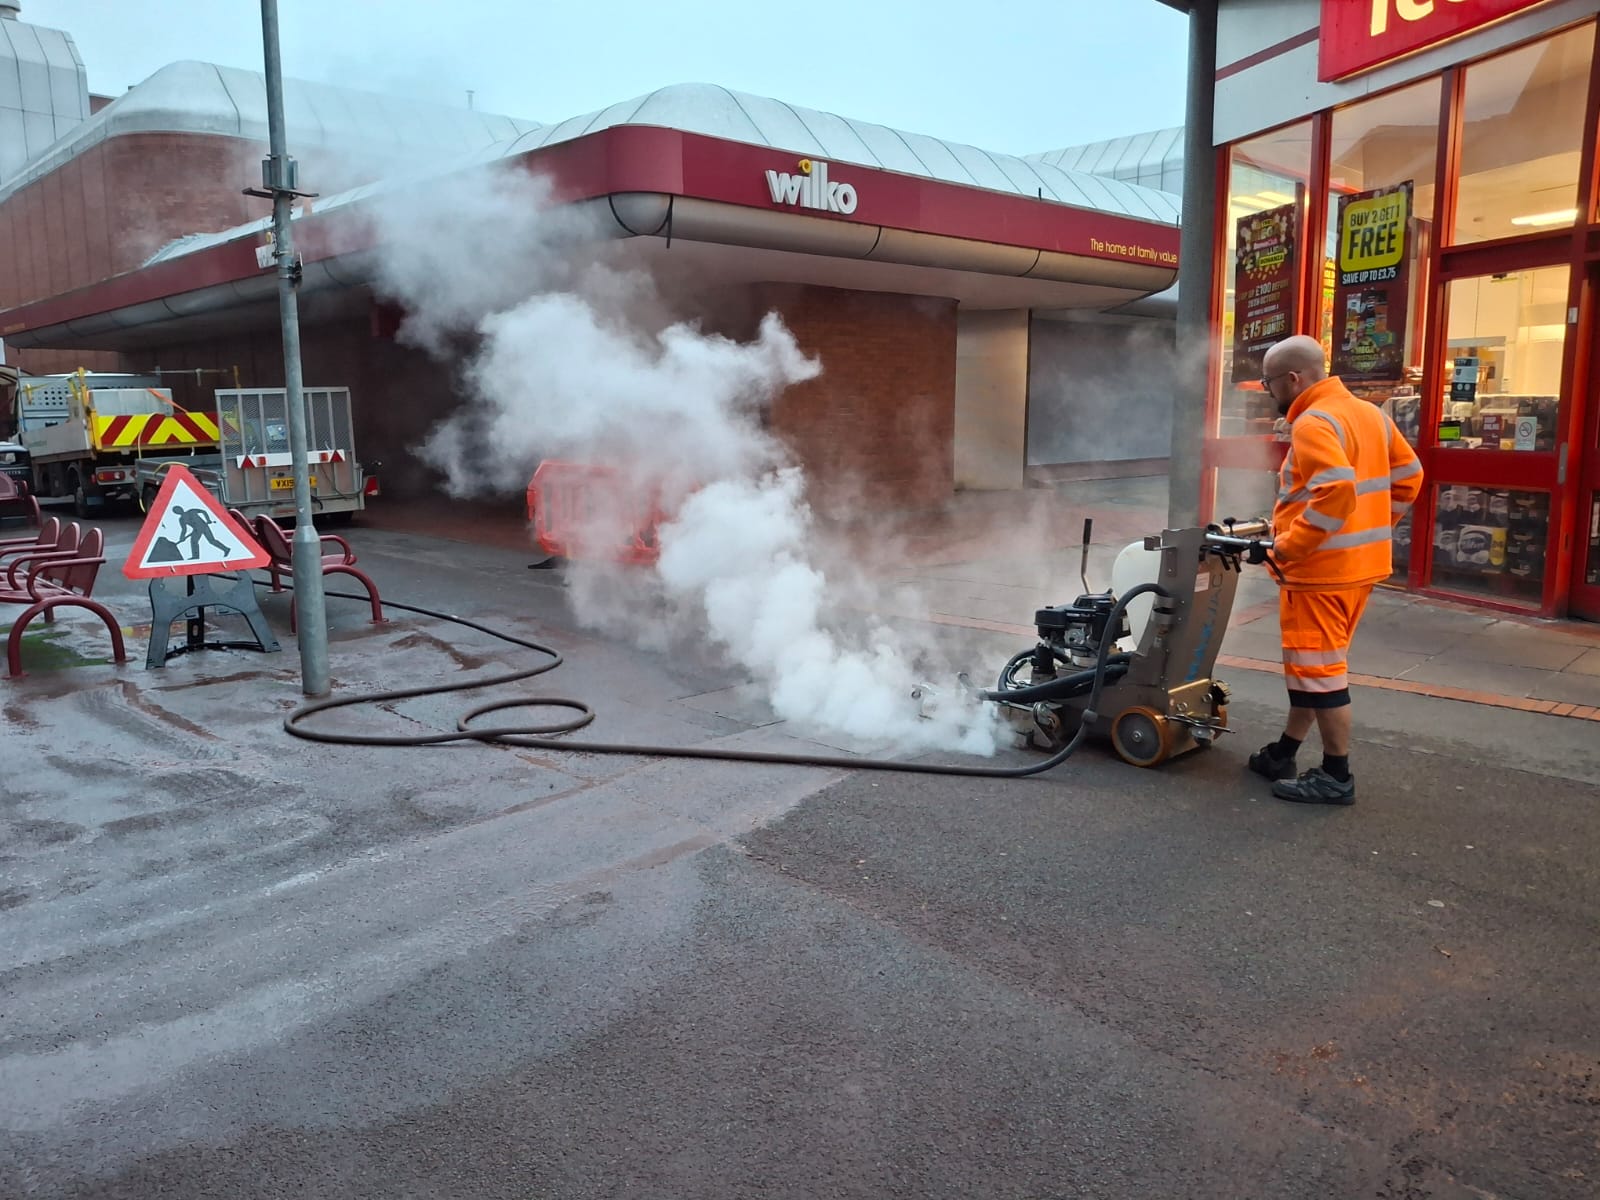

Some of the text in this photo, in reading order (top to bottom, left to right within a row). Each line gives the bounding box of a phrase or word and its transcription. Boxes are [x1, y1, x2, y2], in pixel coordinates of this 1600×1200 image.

[765, 159, 858, 214] wilko
[1350, 212, 1369, 227] BUY
[1372, 210, 1378, 223] 2
[1380, 205, 1395, 221] GET
[1090, 238, 1178, 264] The home of family value
[1348, 221, 1398, 260] FREE
[1342, 266, 1397, 285] SAVE UP TO £3.75
[1242, 319, 1262, 341] £15
